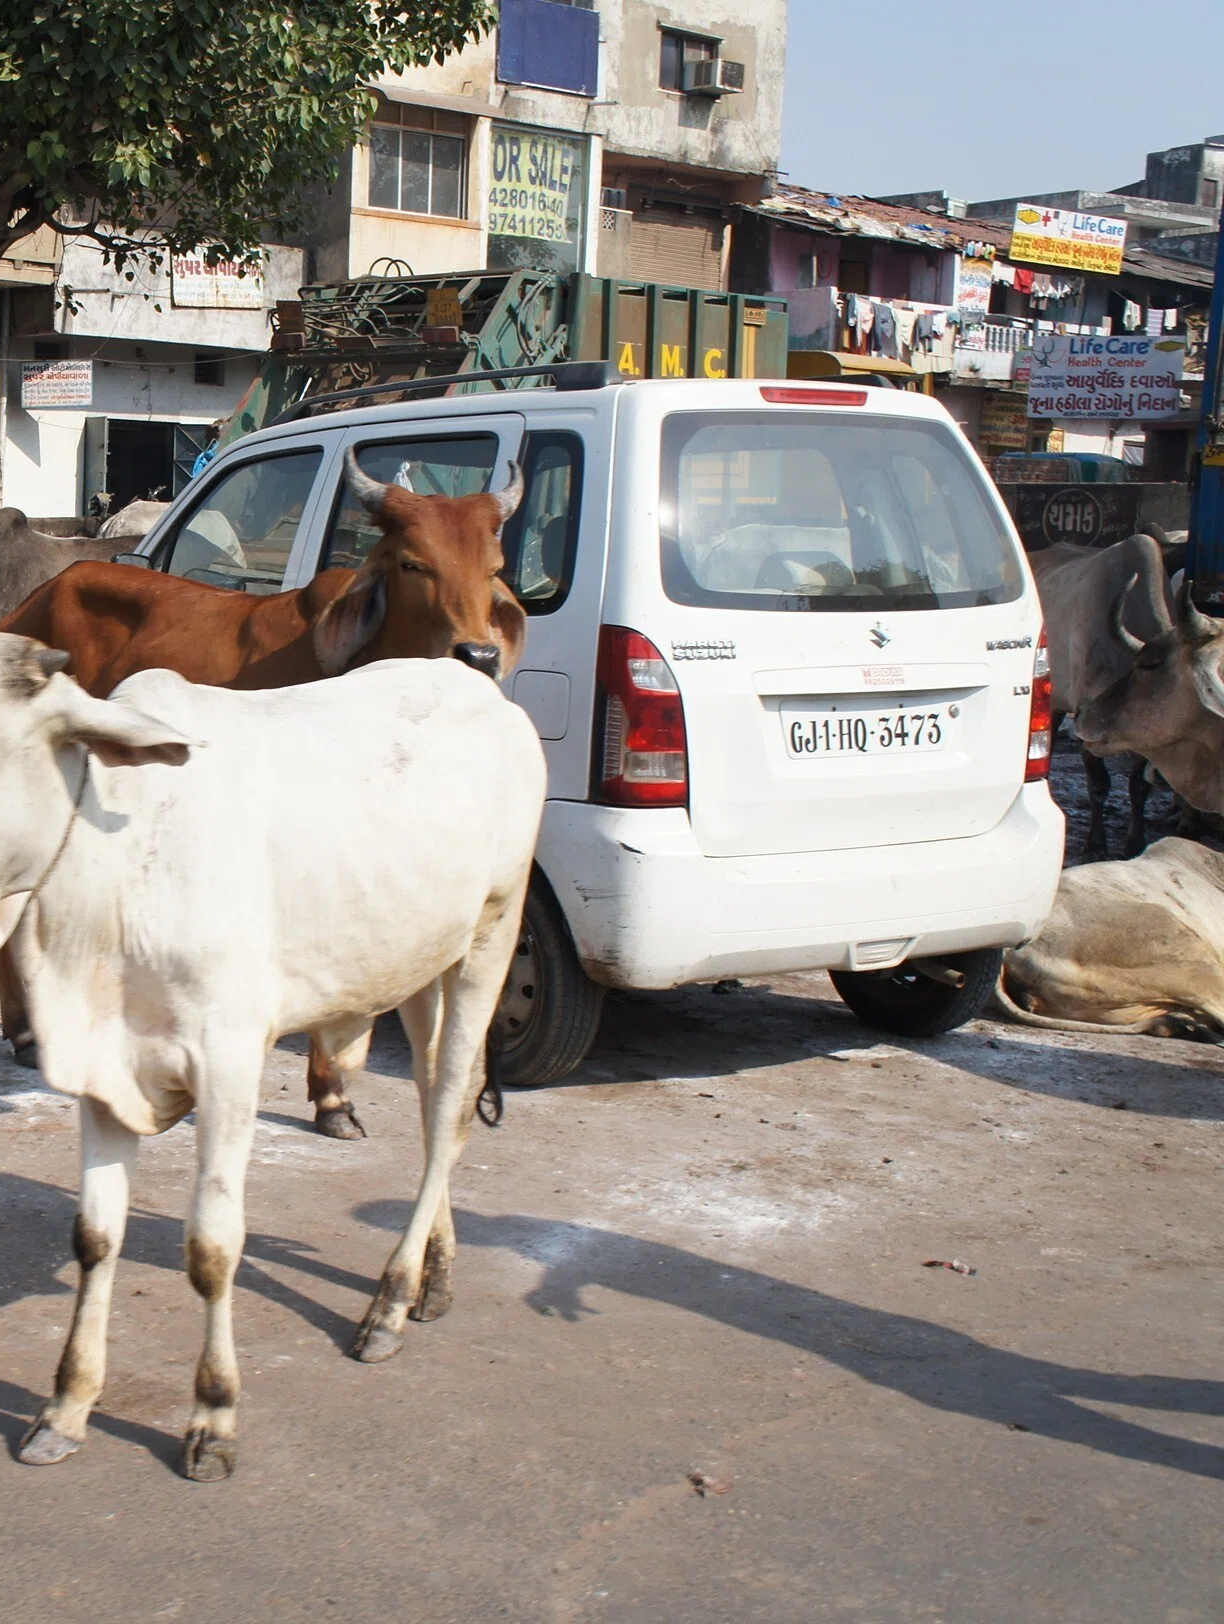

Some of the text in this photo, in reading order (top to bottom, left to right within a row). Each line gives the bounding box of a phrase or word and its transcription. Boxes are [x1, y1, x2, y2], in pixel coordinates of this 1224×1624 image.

[528, 137, 569, 194] SALE
[1071, 230, 1121, 246] Health Center
[618, 343, 726, 379] A. M. C.
[1067, 356, 1148, 368] Health Center
[672, 649, 736, 661] SUZUKI
